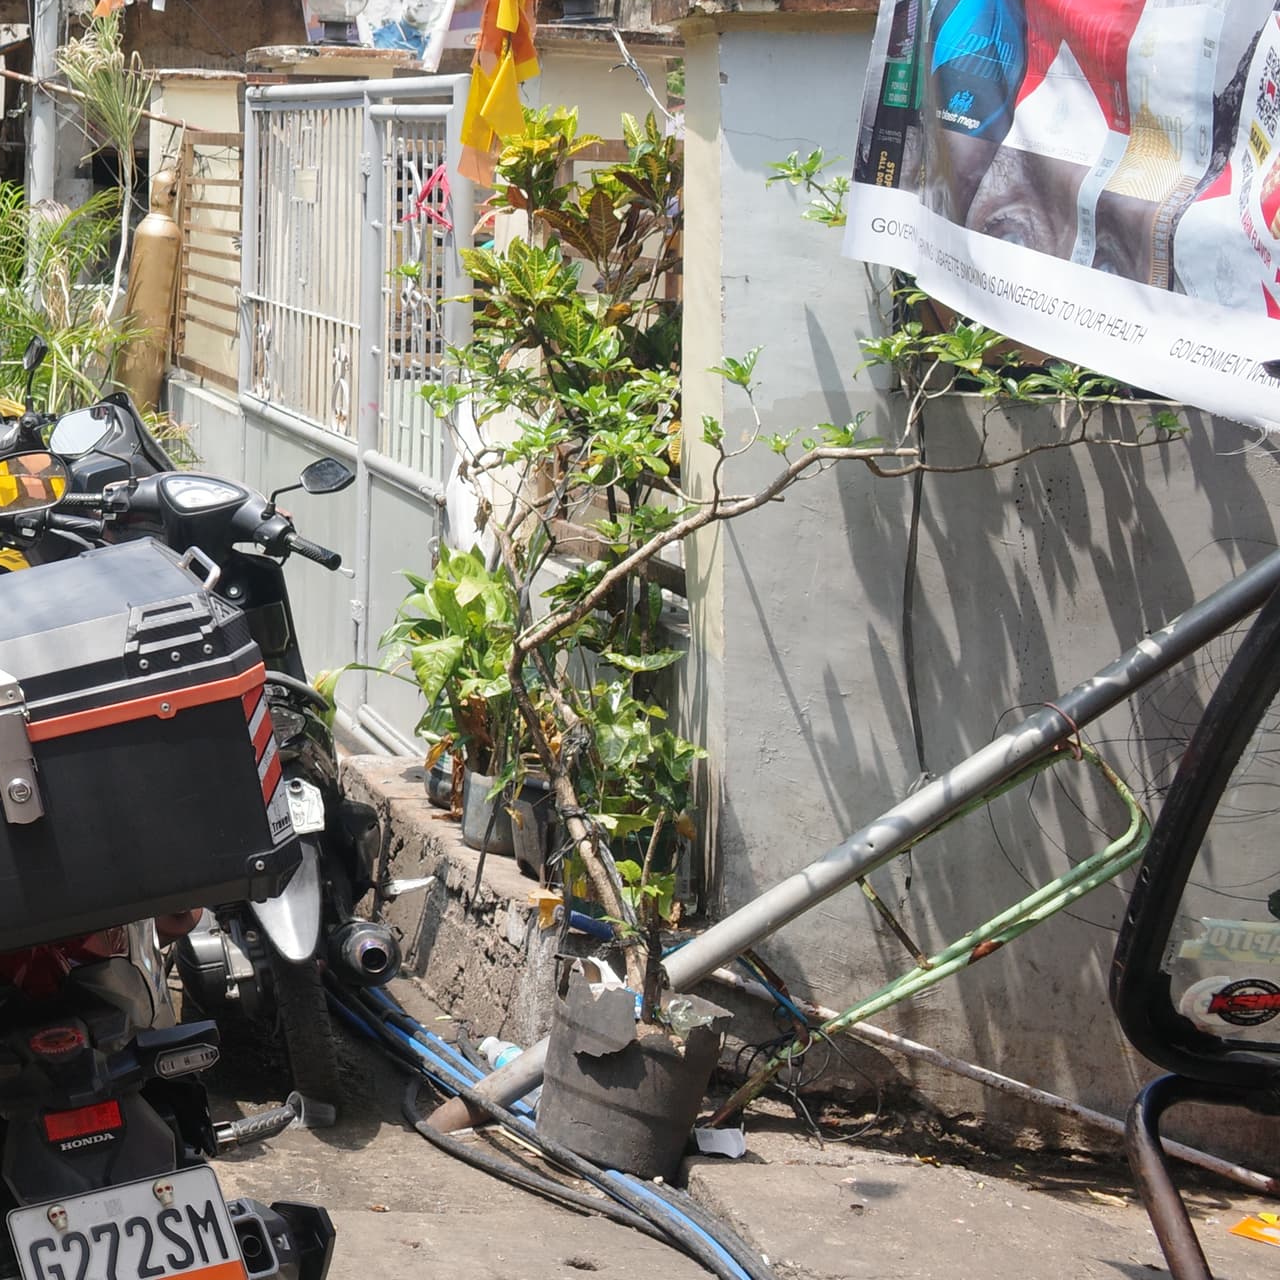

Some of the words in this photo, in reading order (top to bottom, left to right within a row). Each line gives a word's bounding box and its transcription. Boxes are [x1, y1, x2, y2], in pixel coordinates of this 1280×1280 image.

[879, 150, 888, 171] CALL
[884, 160, 896, 188] STOP
[871, 217, 918, 242] GOVERN
[959, 258, 987, 291] SMOKING
[988, 274, 996, 295] IS
[996, 278, 1058, 315] DANGEROUS
[1058, 300, 1075, 321] TO
[1073, 307, 1107, 332] YOUR
[1102, 314, 1149, 345] HEALTH
[1169, 337, 1252, 377] GOVERNMENT
[272, 811, 293, 833] Travel
[60, 1132, 116, 1152] HONDA
[28, 1199, 230, 1280] G272SM
